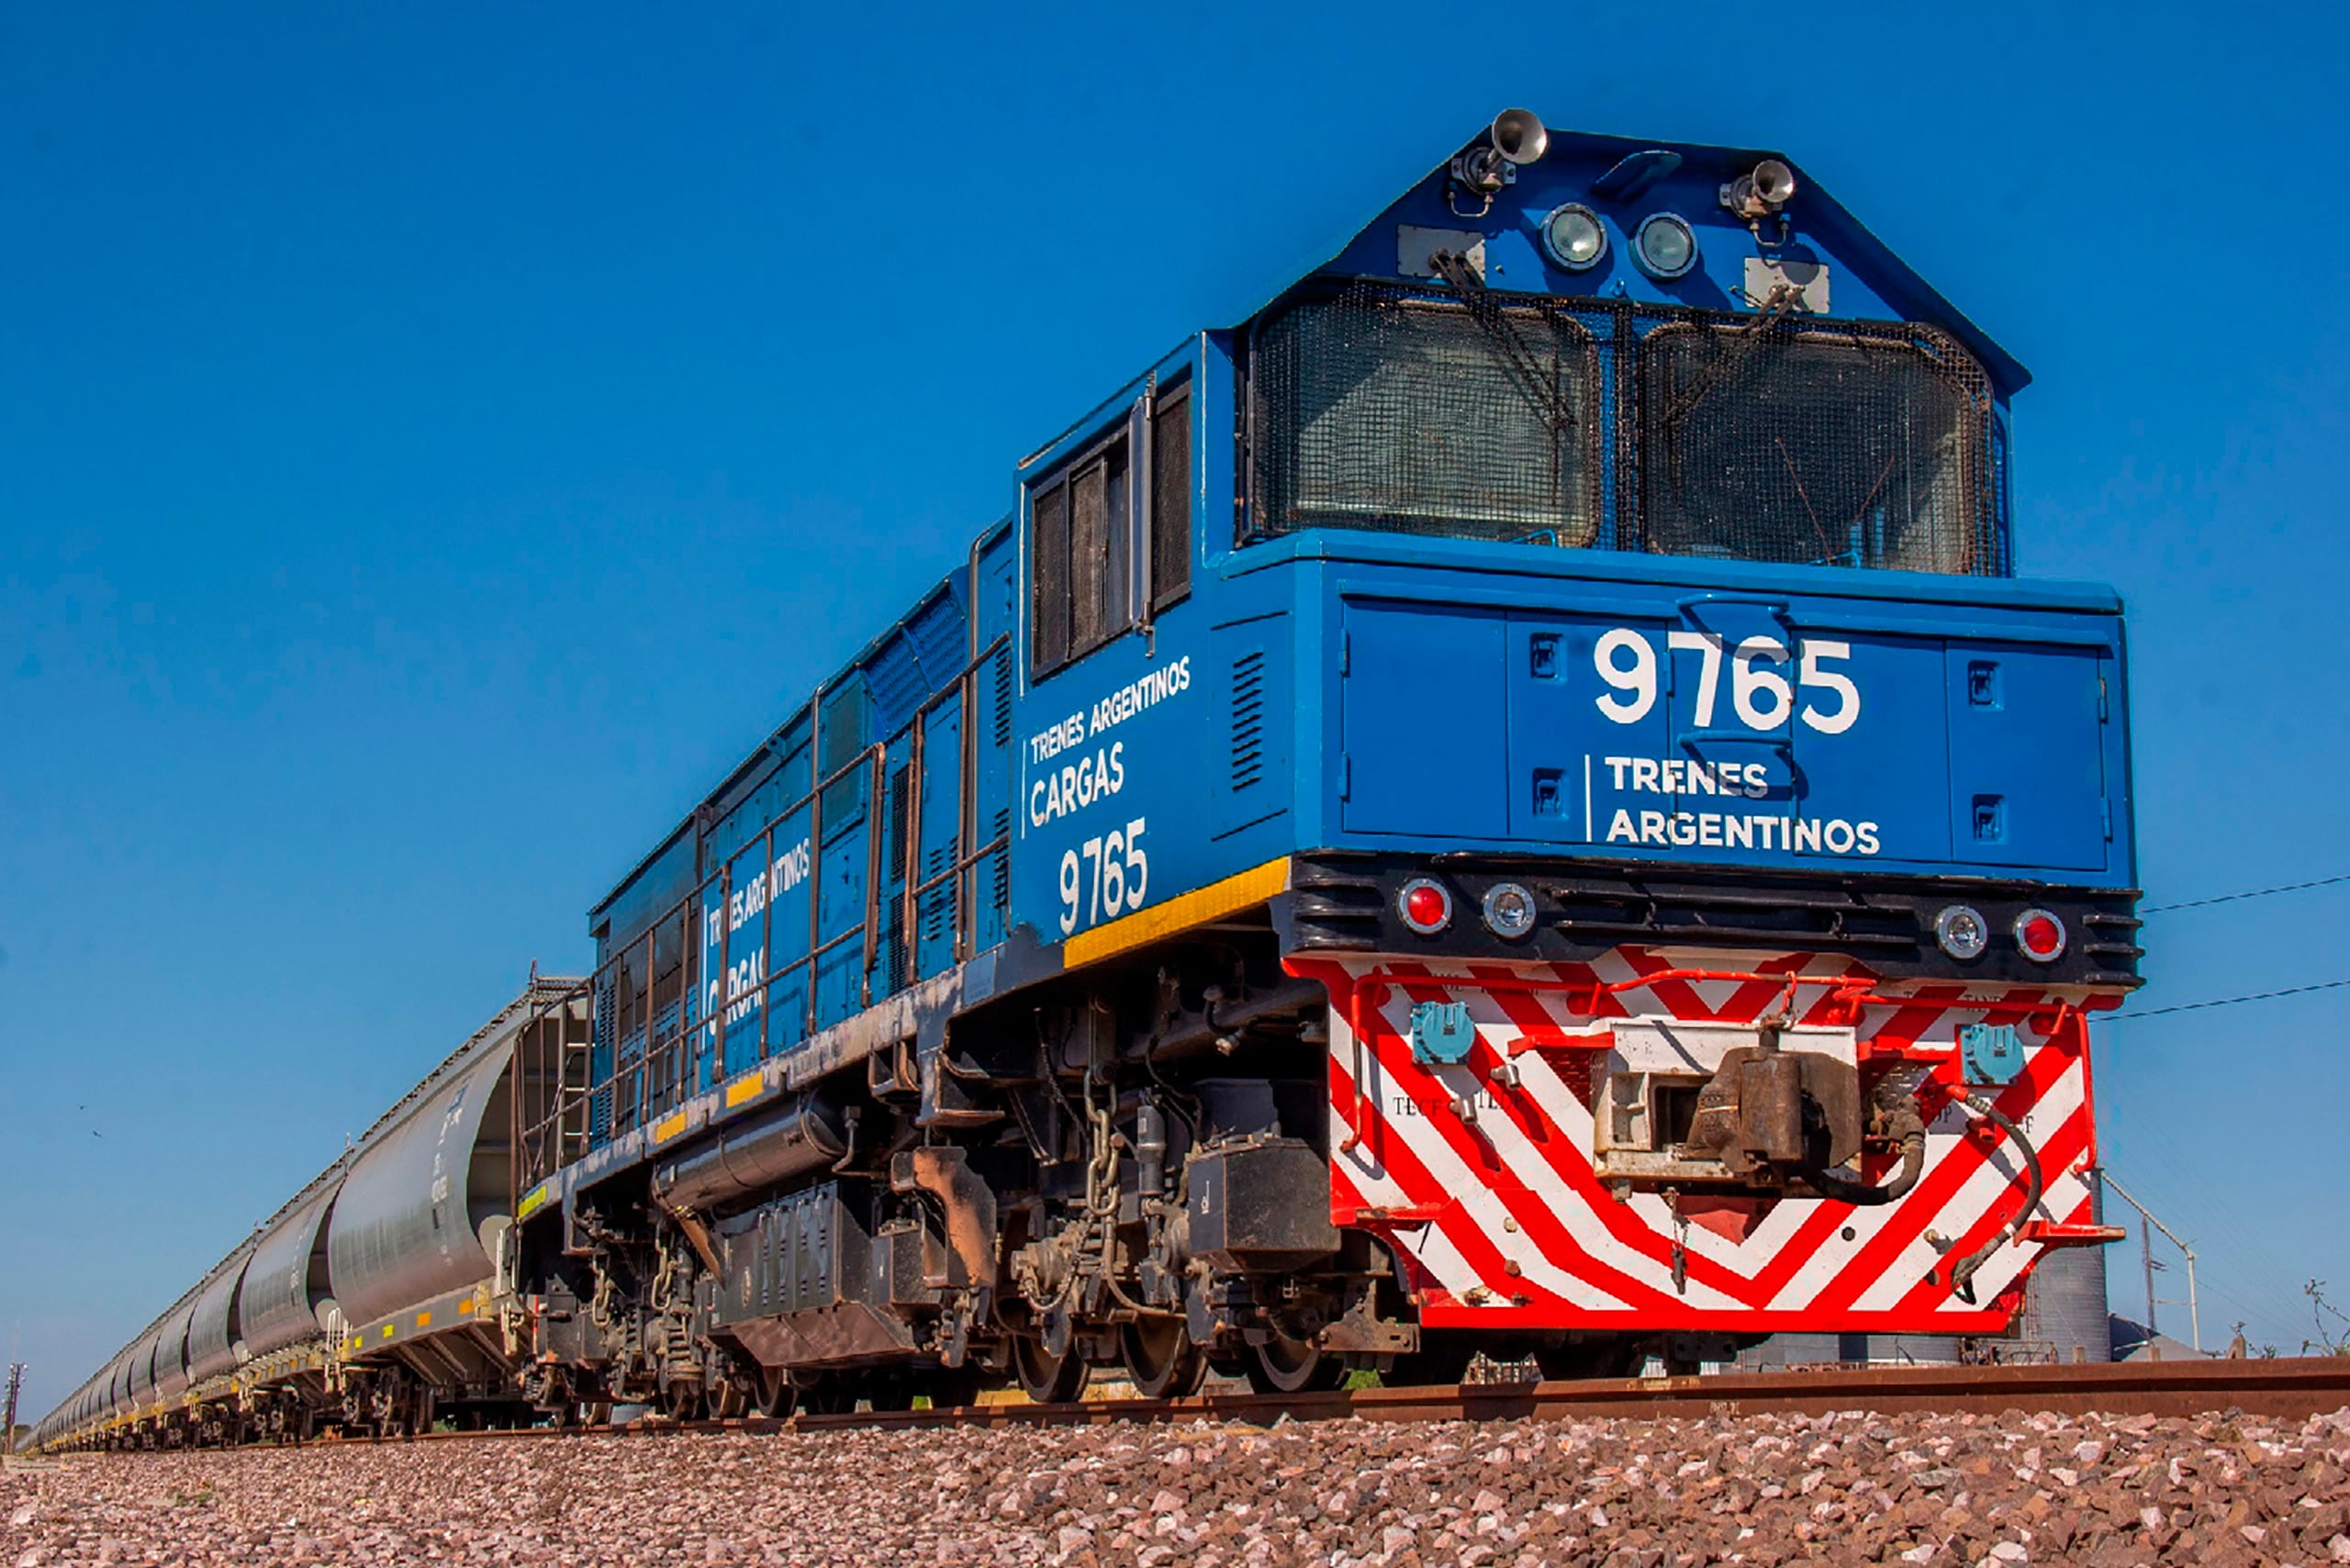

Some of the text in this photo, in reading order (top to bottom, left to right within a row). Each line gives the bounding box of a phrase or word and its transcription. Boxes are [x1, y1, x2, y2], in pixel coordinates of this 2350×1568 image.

[1031, 655, 1190, 764] TRENES ARGENTINOS
[1594, 628, 1860, 734] 9765
[1031, 742, 1124, 827] CARGAS
[1605, 756, 1768, 798] TRENES
[1606, 809, 1881, 855] ARGENTINOS
[744, 837, 811, 922] ARGNTINOS
[1059, 817, 1147, 935] 9765
